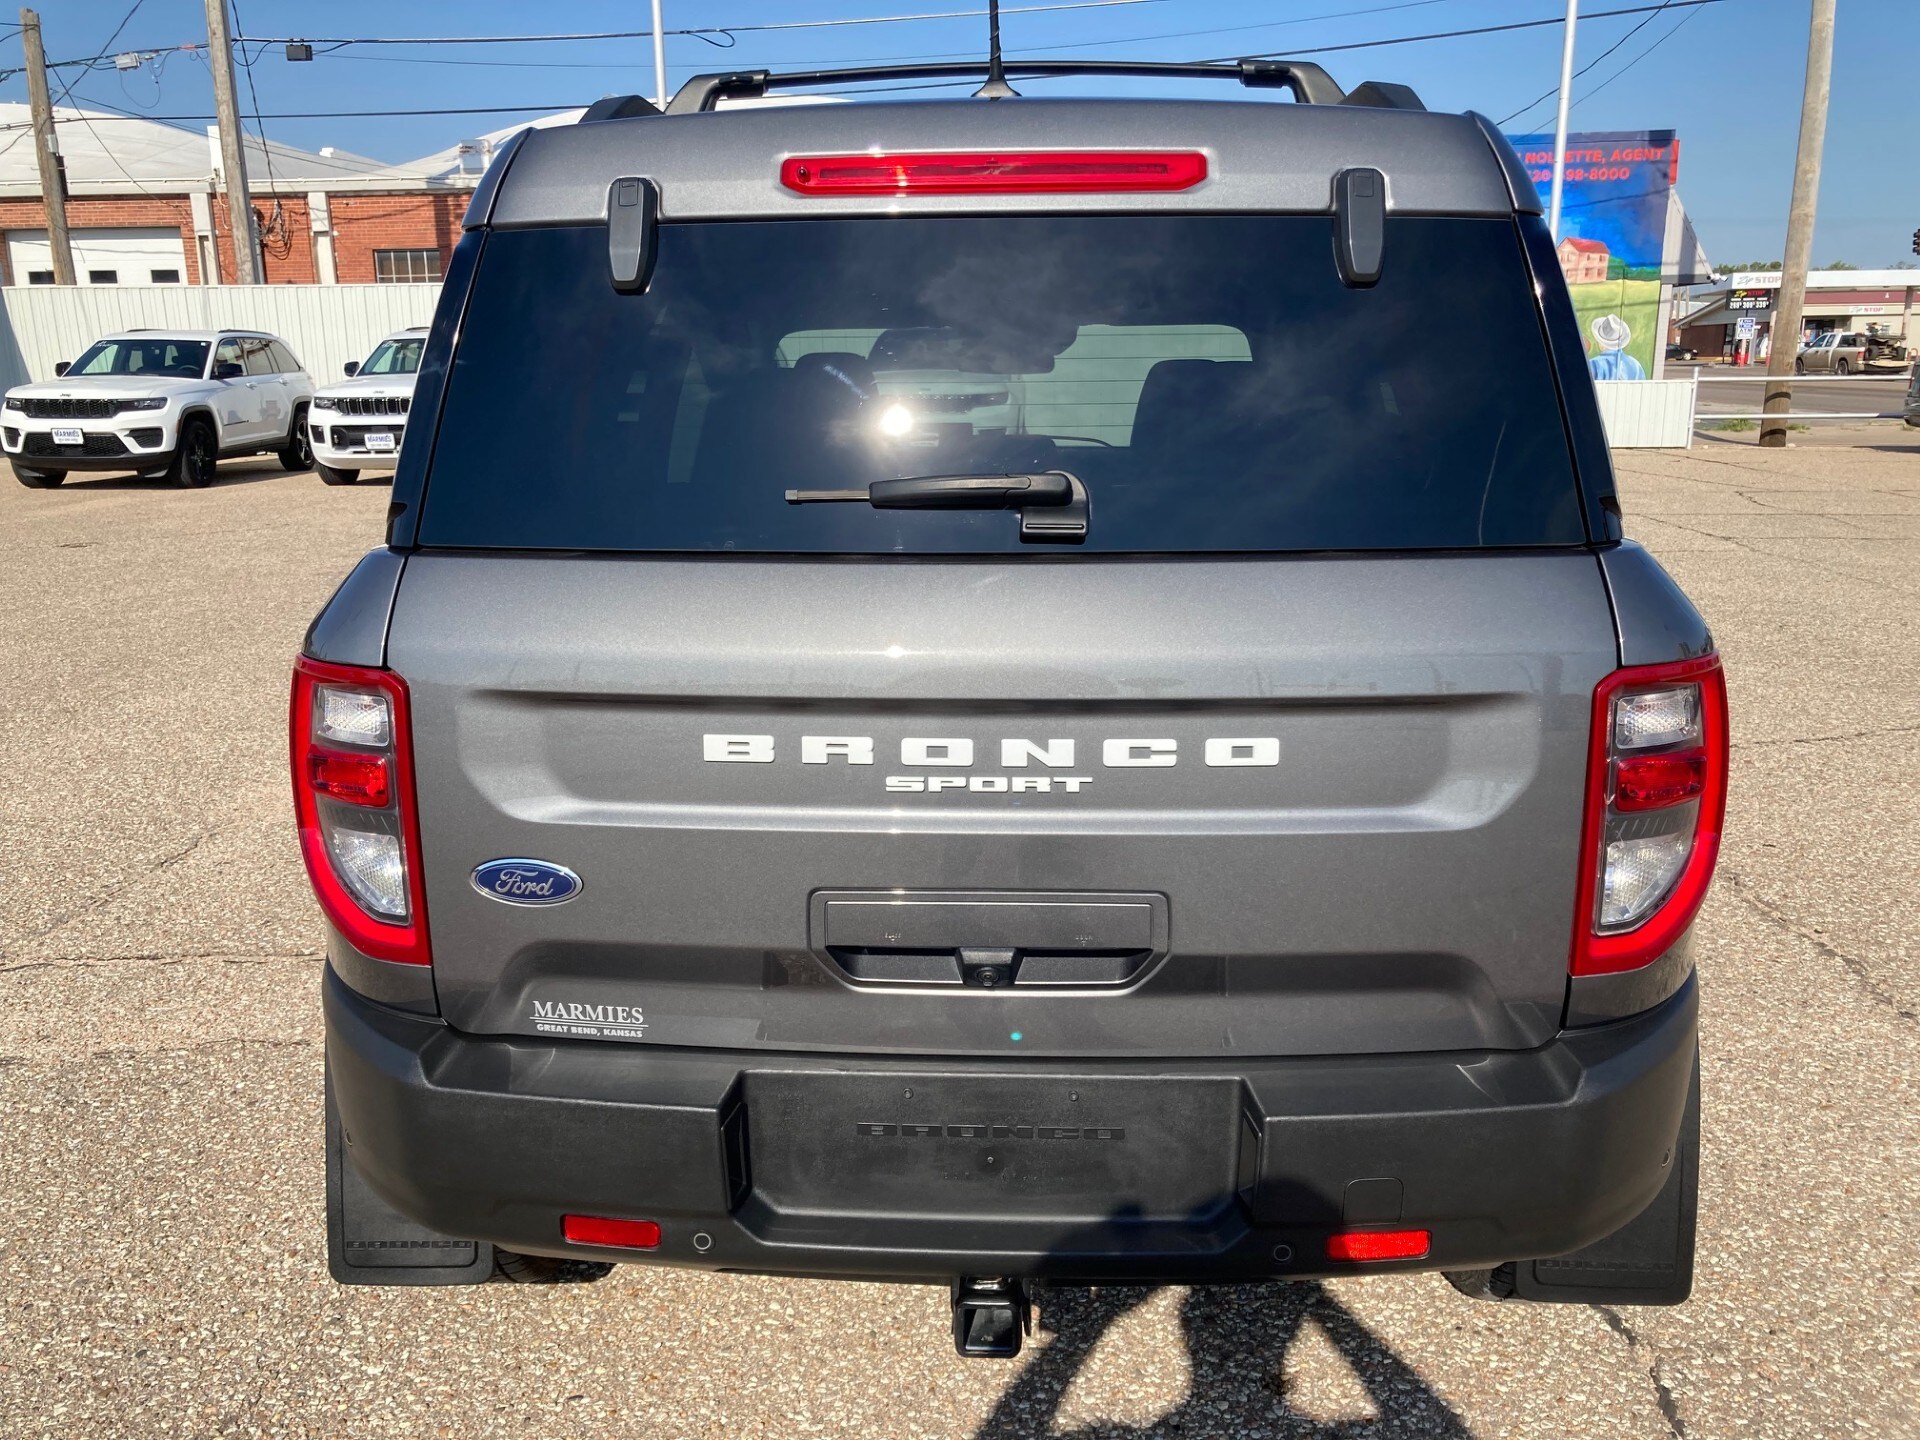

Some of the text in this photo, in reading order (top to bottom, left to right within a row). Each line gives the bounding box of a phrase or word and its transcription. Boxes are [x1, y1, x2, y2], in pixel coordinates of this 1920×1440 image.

[1610, 147, 1665, 162] AGENT
[1755, 276, 1782, 284] STOP
[702, 733, 1280, 768] BRONCO
[885, 775, 1093, 793] SPORT
[494, 869, 554, 896] Ford
[532, 1000, 645, 1024] MARMIES
[536, 1023, 643, 1038] GREAT BEND, KANSAS
[856, 1122, 1126, 1140] BRONCO
[346, 1240, 472, 1251] BRONCO
